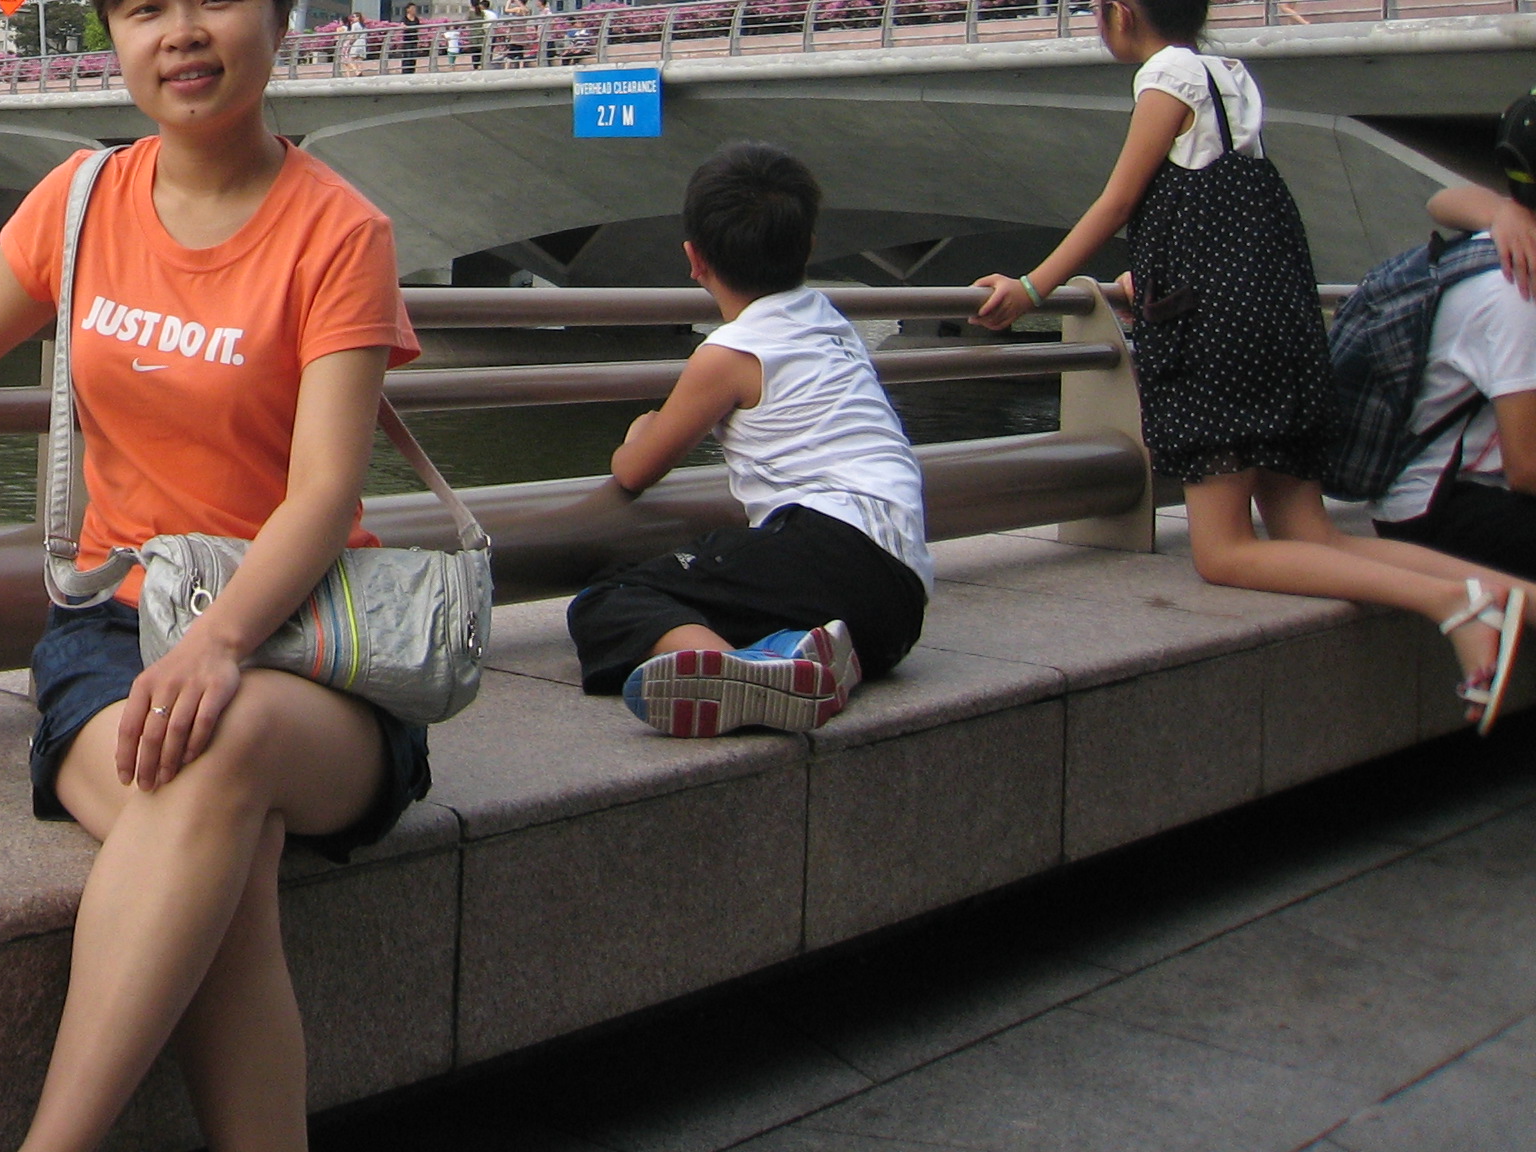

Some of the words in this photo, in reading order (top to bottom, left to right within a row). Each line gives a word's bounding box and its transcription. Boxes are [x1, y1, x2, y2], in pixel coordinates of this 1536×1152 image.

[575, 81, 613, 96] OVERHEAD
[613, 79, 657, 95] CLEARANCE
[597, 105, 616, 127] 2.7
[622, 104, 634, 126] M
[81, 295, 162, 347] JUST
[157, 315, 206, 357] DO
[204, 327, 245, 366] IT.
